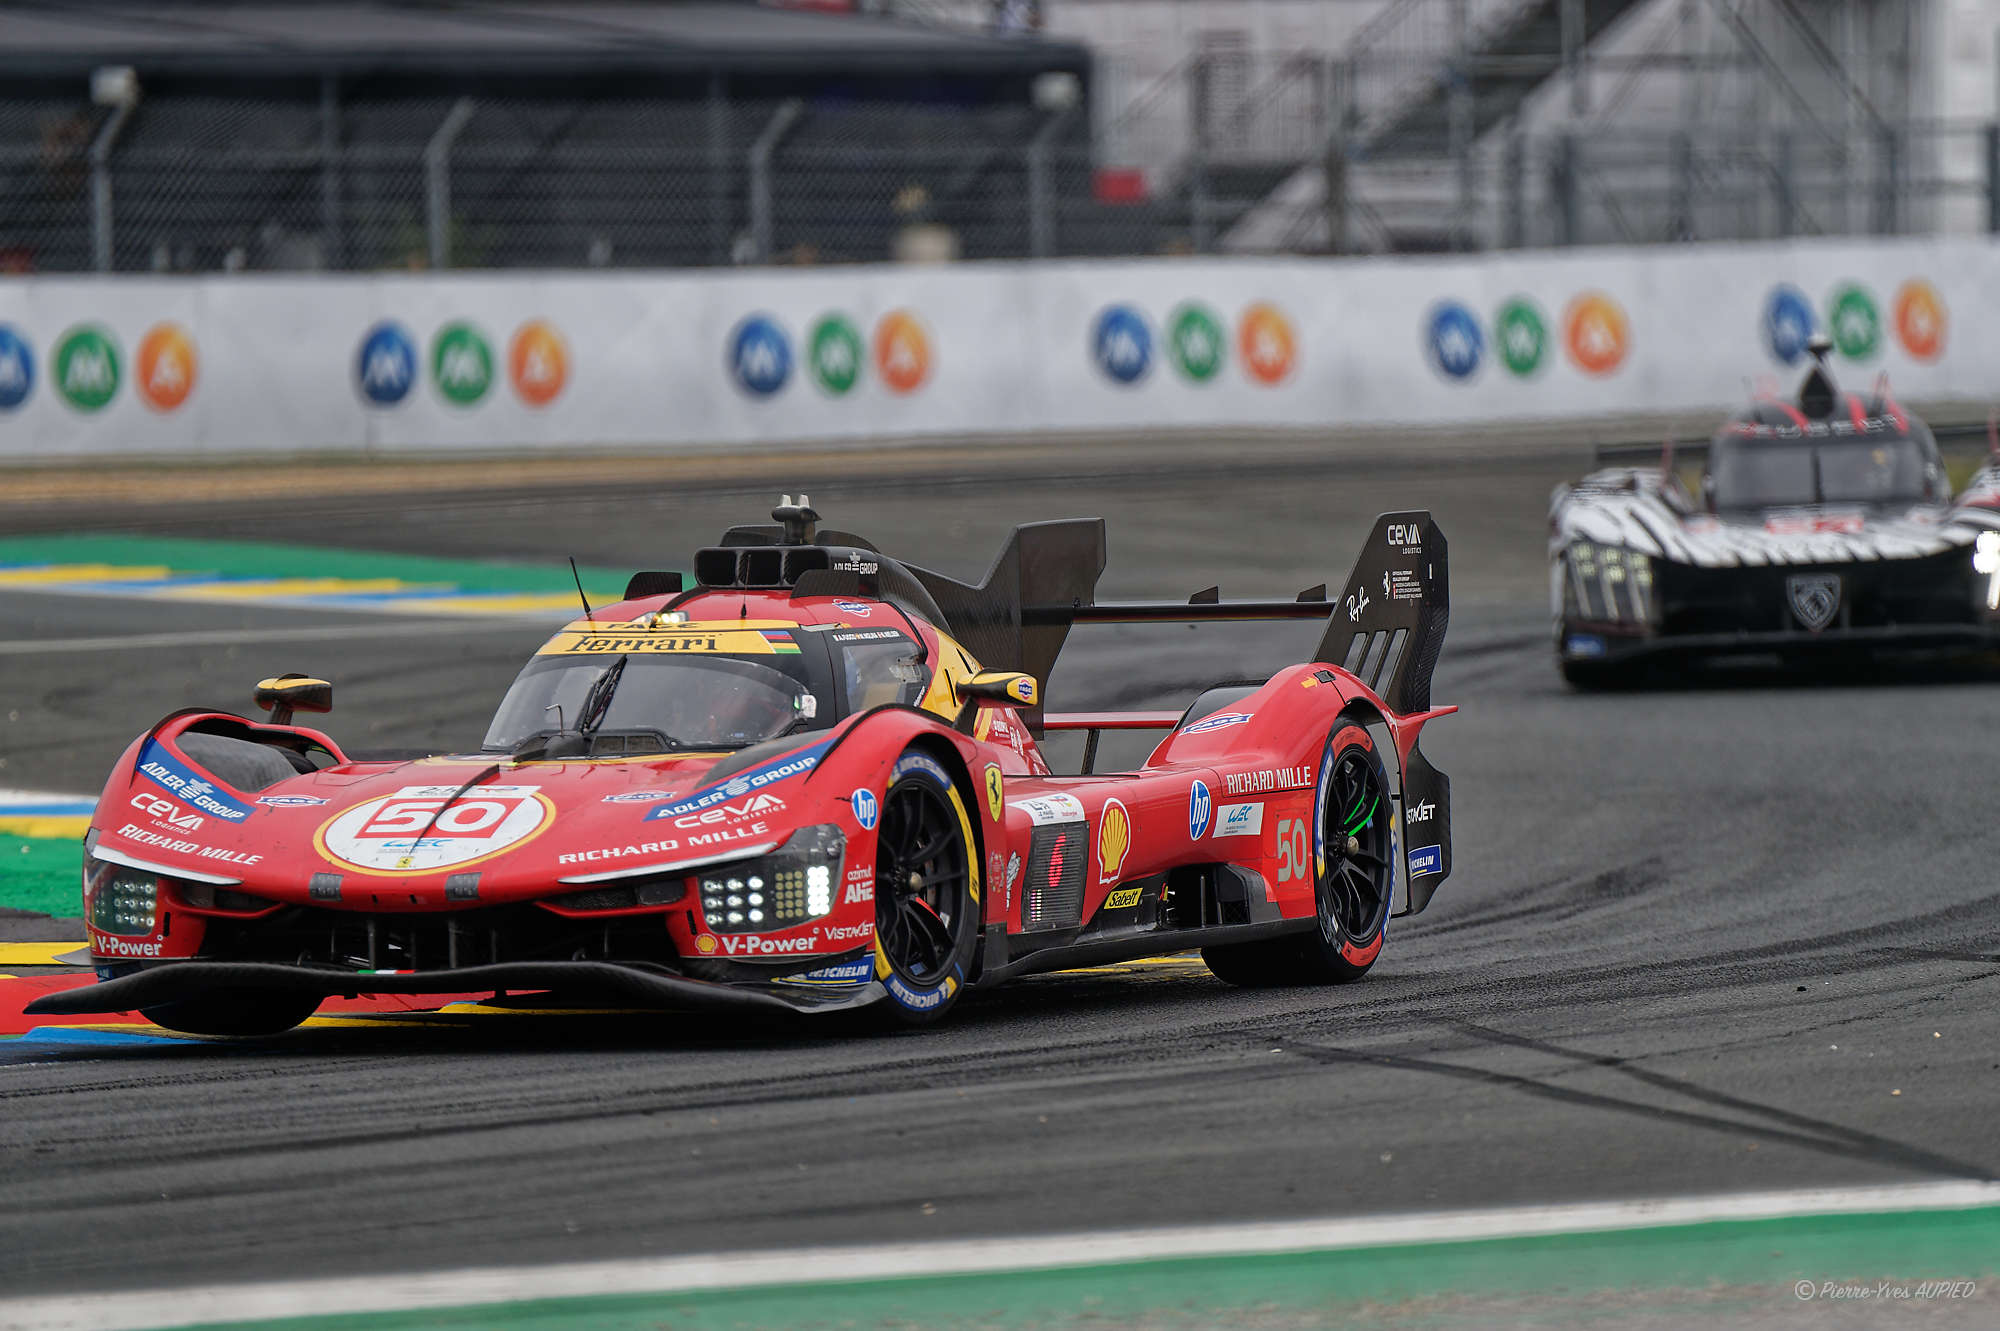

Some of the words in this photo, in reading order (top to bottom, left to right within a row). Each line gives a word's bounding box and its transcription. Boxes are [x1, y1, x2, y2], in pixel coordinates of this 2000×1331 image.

[860, 563, 878, 575] GROUP
[566, 635, 719, 652] Ferrari
[140, 761, 186, 790] ADLER
[193, 795, 246, 819] GROUP
[657, 790, 726, 818] ADLER
[751, 756, 817, 787] GROUP
[1227, 771, 1274, 795] RICHARD
[1277, 766, 1311, 787] MILLE
[365, 801, 507, 833] 50
[727, 803, 787, 825] LOGISTICS
[857, 792, 876, 827] hp
[1190, 787, 1210, 838] hp
[117, 823, 199, 853] RICHARD
[196, 846, 263, 865] MILLE
[558, 839, 679, 864] RICHARD
[688, 821, 769, 847] MILLE
[1277, 818, 1306, 882] 50
[847, 864, 872, 881] azimut
[1108, 891, 1138, 907] Sabelt
[97, 935, 162, 956] V-Power
[722, 933, 818, 954] V-Power
